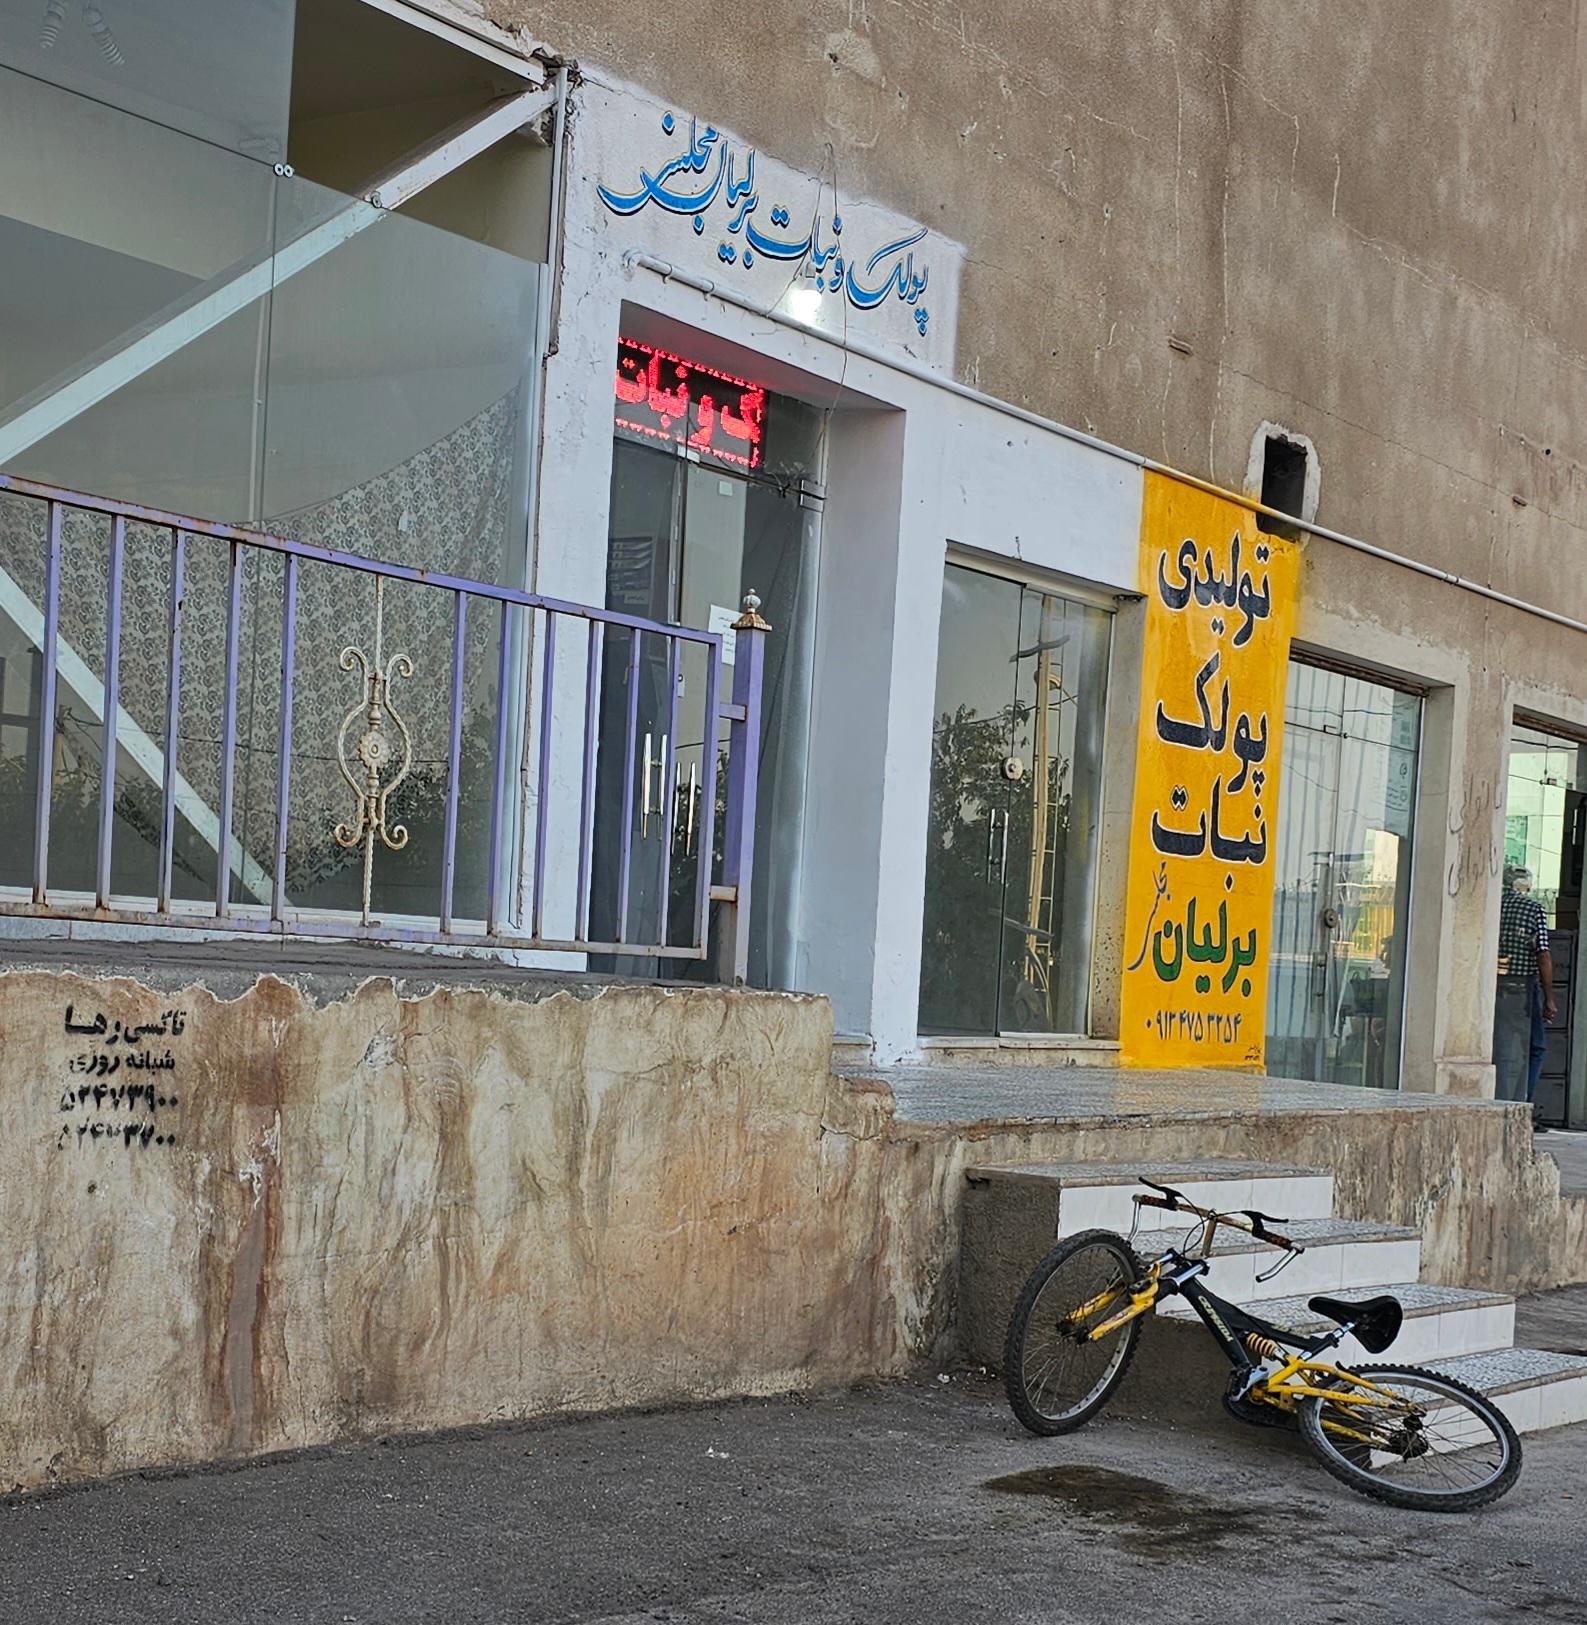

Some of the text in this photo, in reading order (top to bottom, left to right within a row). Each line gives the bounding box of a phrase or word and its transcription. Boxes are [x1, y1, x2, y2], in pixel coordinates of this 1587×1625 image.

[640, 110, 758, 268] برلیان
[746, 203, 842, 294] نبات
[829, 256, 845, 293] و
[846, 226, 929, 336] پولک
[614, 350, 690, 430] نبات
[690, 394, 715, 446] و
[1159, 530, 1269, 647] تولیدی
[1156, 651, 1267, 795] پولک
[1151, 774, 1267, 890] نبات
[1152, 895, 1257, 998] برلیان
[69, 1049, 176, 1077] شبانه روزی
[124, 1009, 187, 1044] تاکسی
